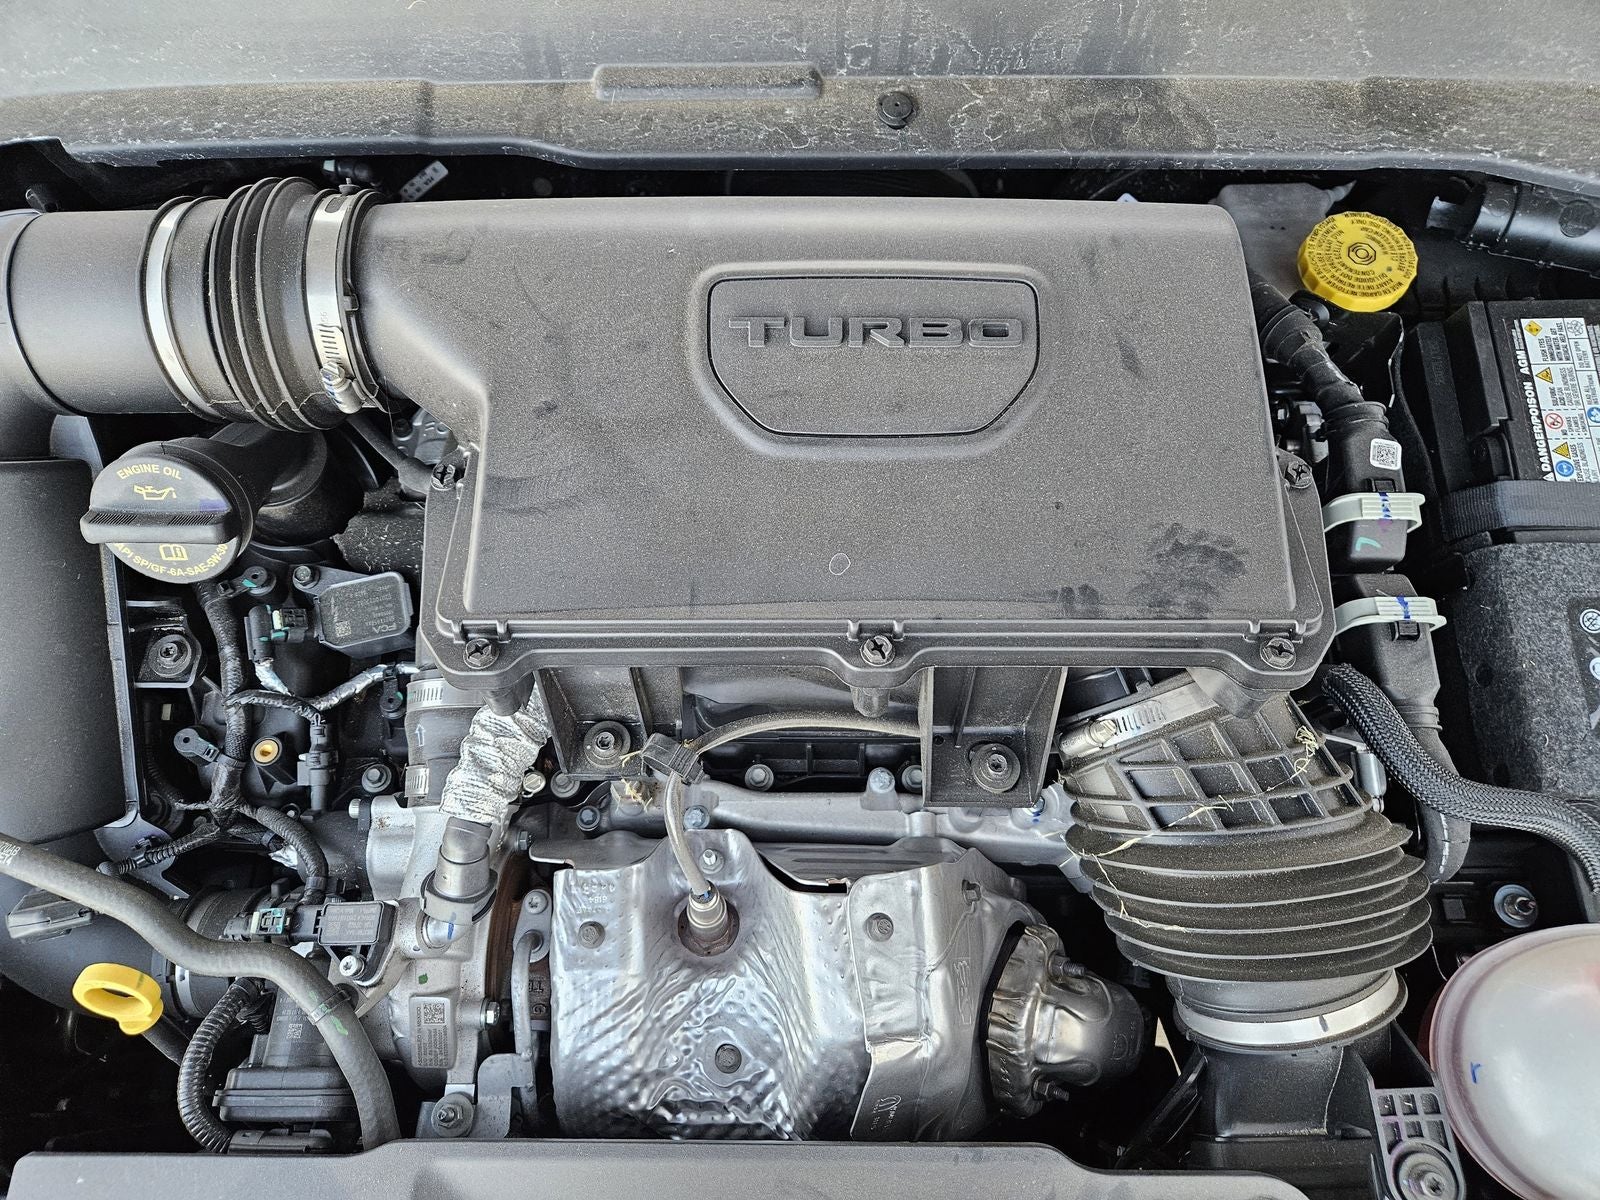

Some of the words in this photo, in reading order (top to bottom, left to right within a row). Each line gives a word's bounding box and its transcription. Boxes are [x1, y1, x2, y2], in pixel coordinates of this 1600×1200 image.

[729, 316, 1023, 348] TURBO
[1515, 350, 1530, 374] AGM
[1522, 381, 1551, 471] DANGER/POISON
[116, 464, 160, 480] ENGINE
[162, 466, 182, 480] OIL
[115, 543, 134, 558] API
